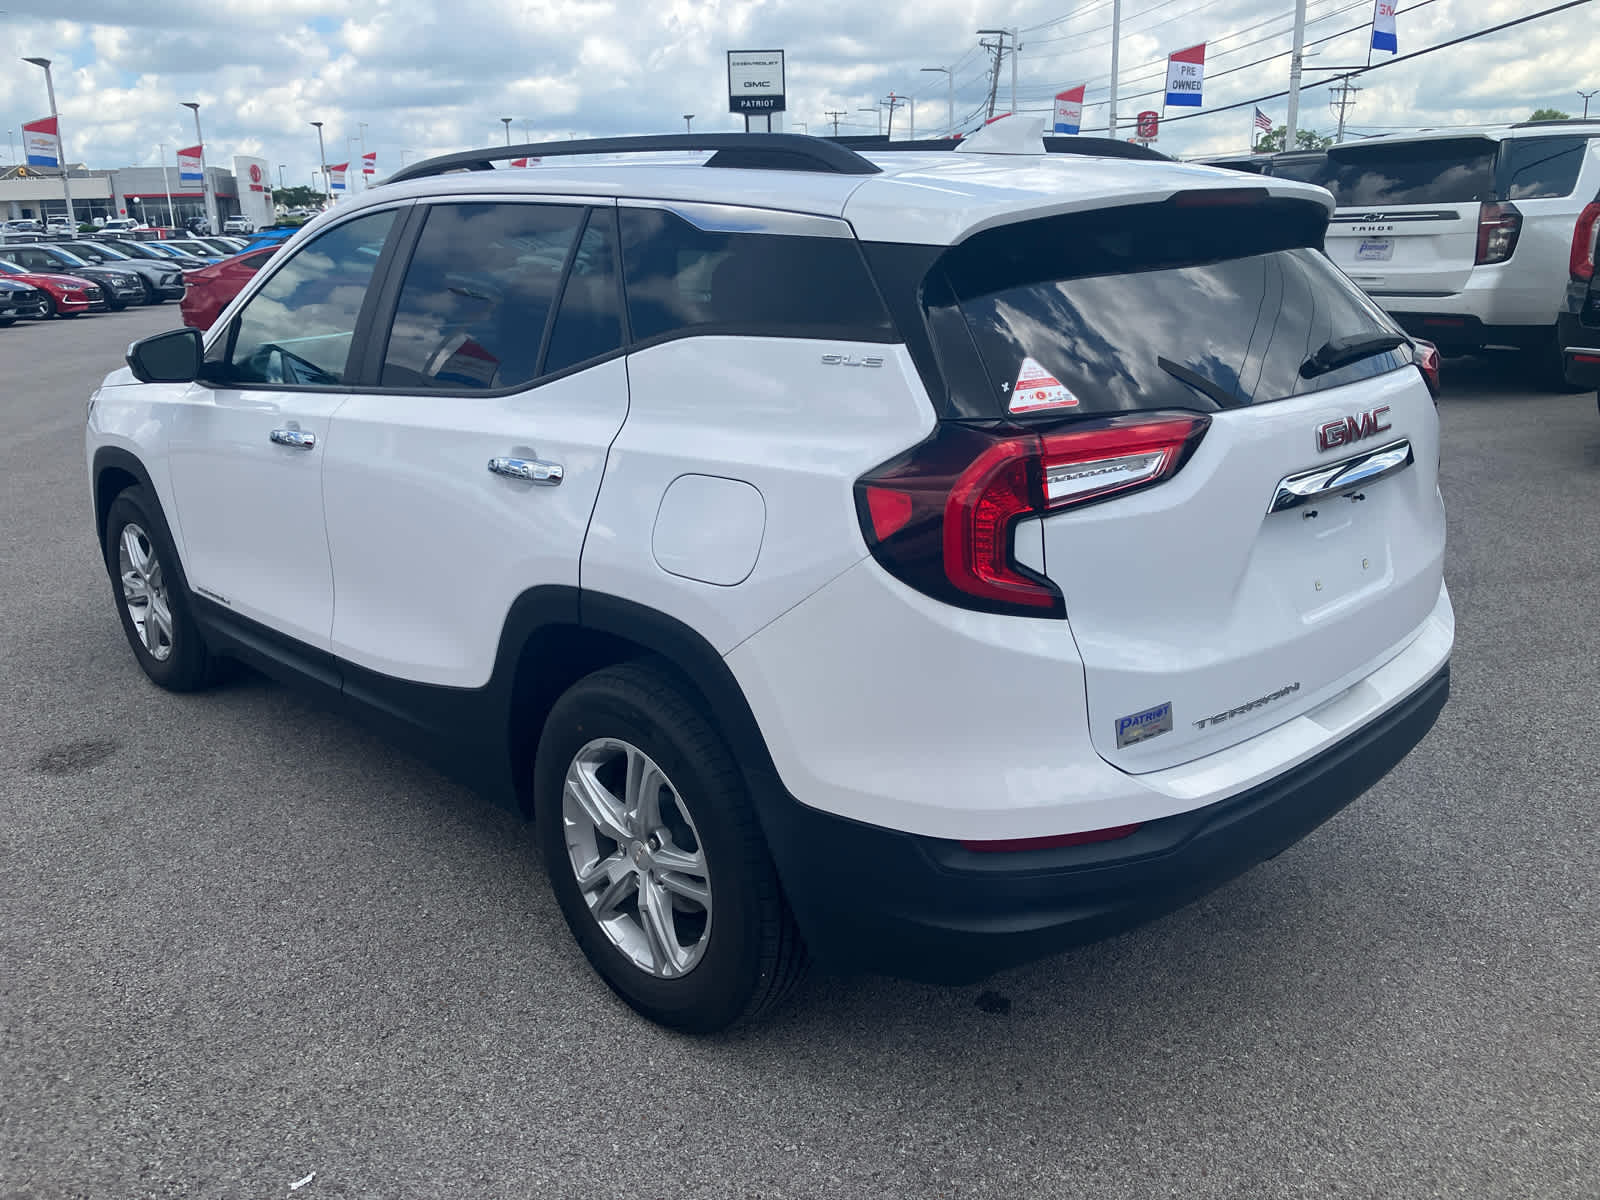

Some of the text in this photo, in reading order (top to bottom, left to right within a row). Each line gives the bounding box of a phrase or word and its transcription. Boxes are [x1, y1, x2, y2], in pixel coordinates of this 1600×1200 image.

[1181, 65, 1197, 76] PRE
[743, 80, 771, 88] GMC
[1172, 80, 1202, 90] OWNED
[740, 99, 774, 108] PATRIOT
[821, 353, 884, 368] SLE
[1315, 405, 1392, 453] GMC
[1119, 704, 1169, 736] PATRIOT
